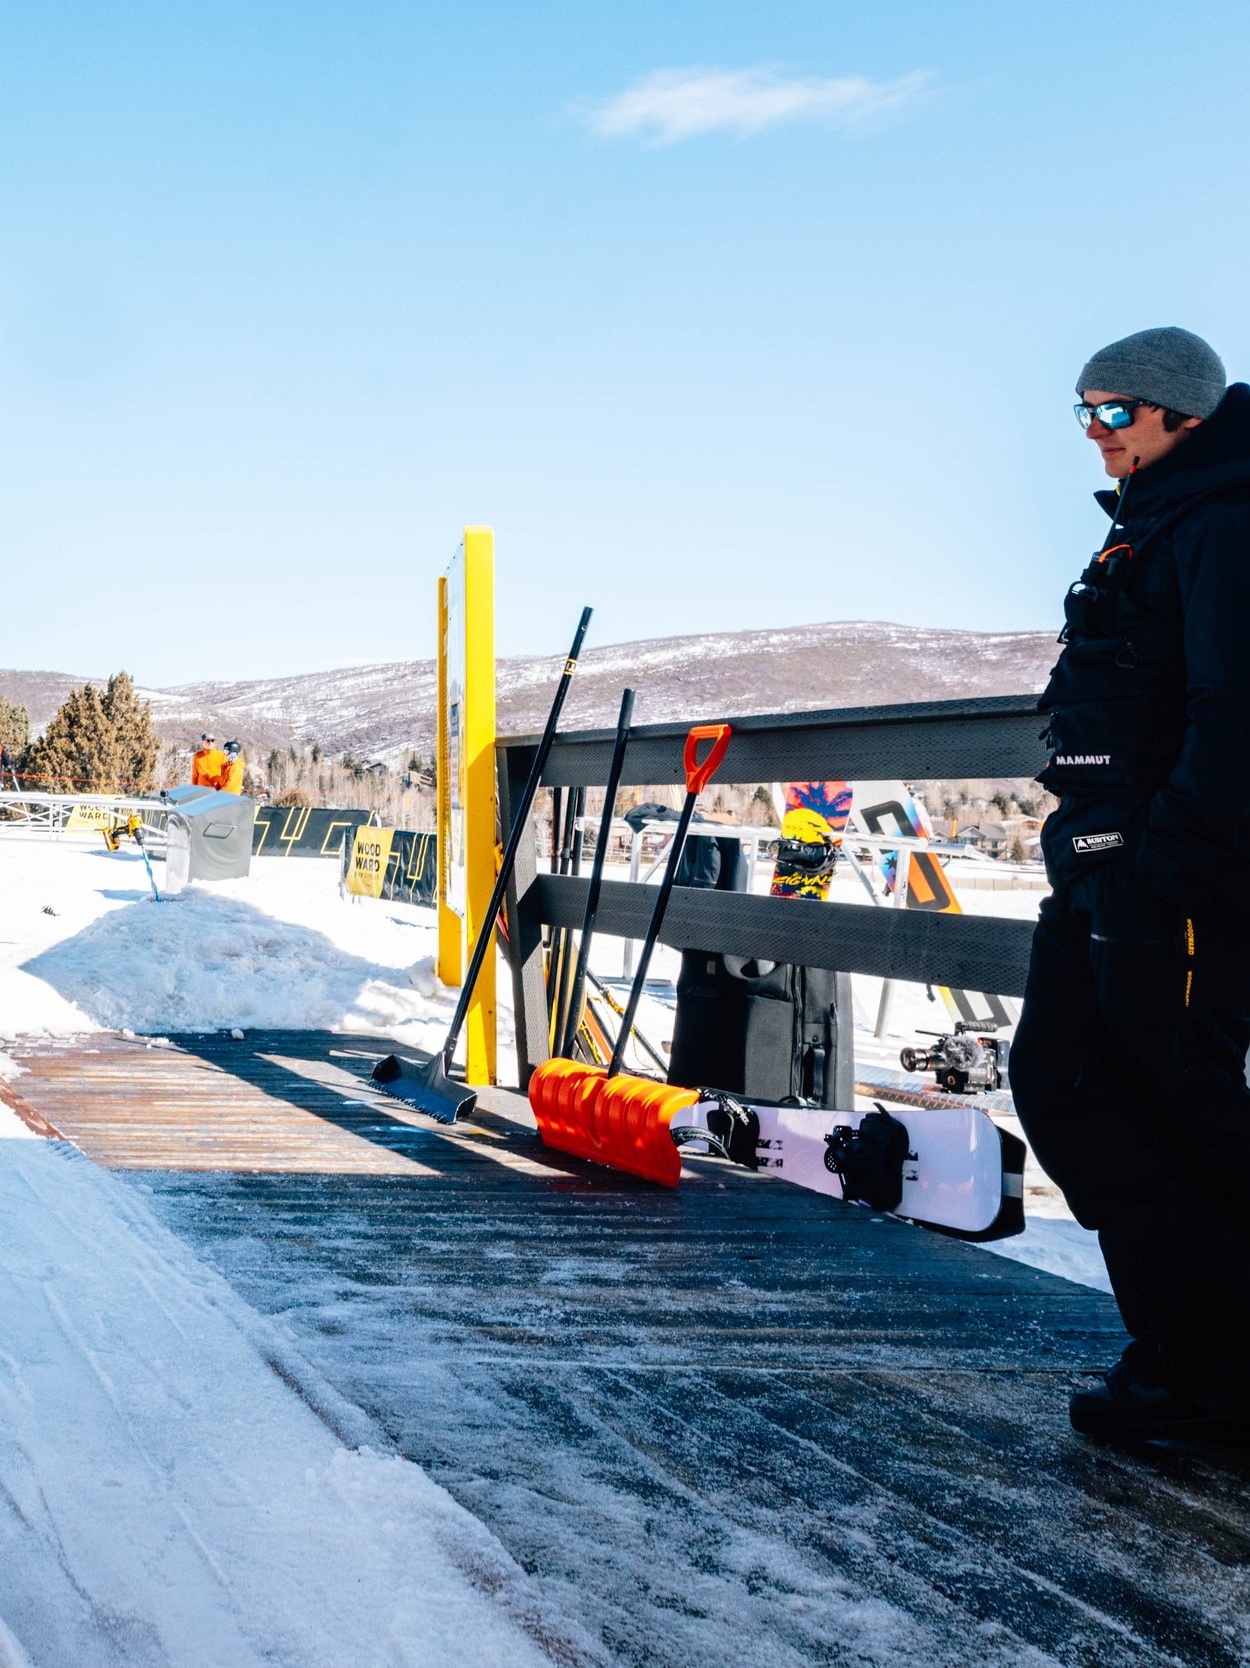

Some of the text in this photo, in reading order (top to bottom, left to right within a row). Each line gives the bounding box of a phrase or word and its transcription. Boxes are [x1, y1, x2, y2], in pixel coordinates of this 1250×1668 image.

[1056, 755, 1110, 765] MAMMUT
[1086, 835, 1119, 844] BURTON
[357, 842, 381, 856] WOOD
[355, 857, 380, 872] WARD
